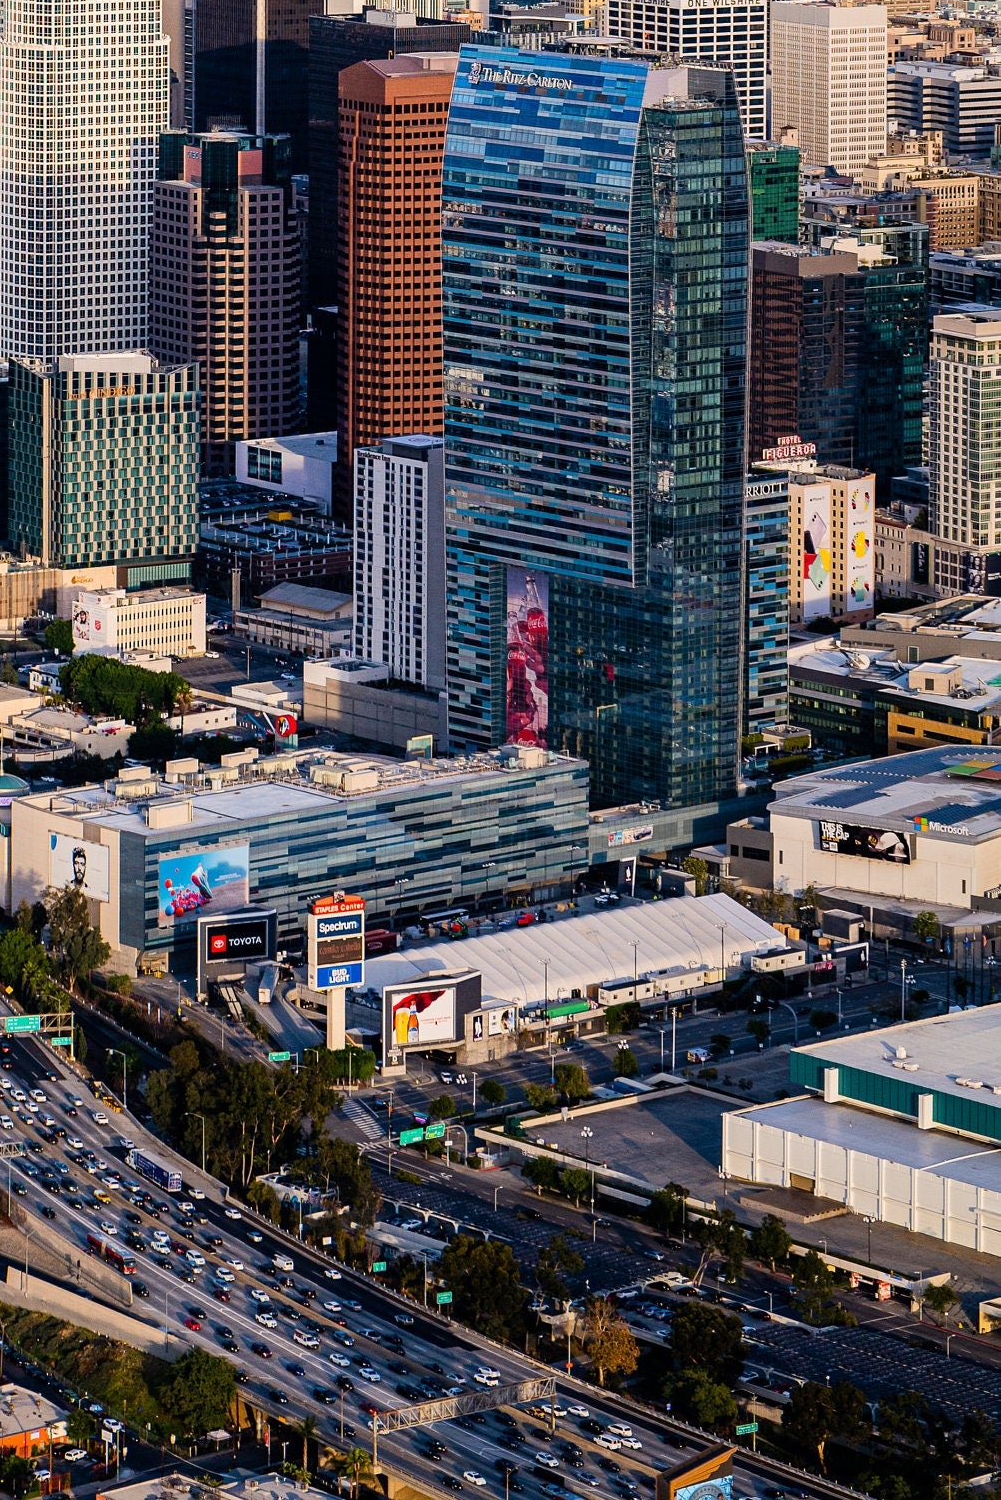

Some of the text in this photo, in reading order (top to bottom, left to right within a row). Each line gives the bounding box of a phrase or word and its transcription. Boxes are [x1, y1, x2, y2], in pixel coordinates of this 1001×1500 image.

[482, 68, 572, 90] THE RITZ-CARLTON
[97, 386, 136, 398] INDIGO
[782, 436, 802, 445] HOTEL
[766, 444, 816, 459] FIGUEROA
[821, 822, 844, 832] THIS IS
[929, 822, 970, 836] Microsoft
[822, 830, 836, 838] THE
[836, 832, 850, 841] CAP
[315, 905, 338, 914] STAPLES
[320, 920, 357, 934] Spectrum
[229, 936, 262, 946] TOYOTA
[329, 974, 350, 983] LIGHT
